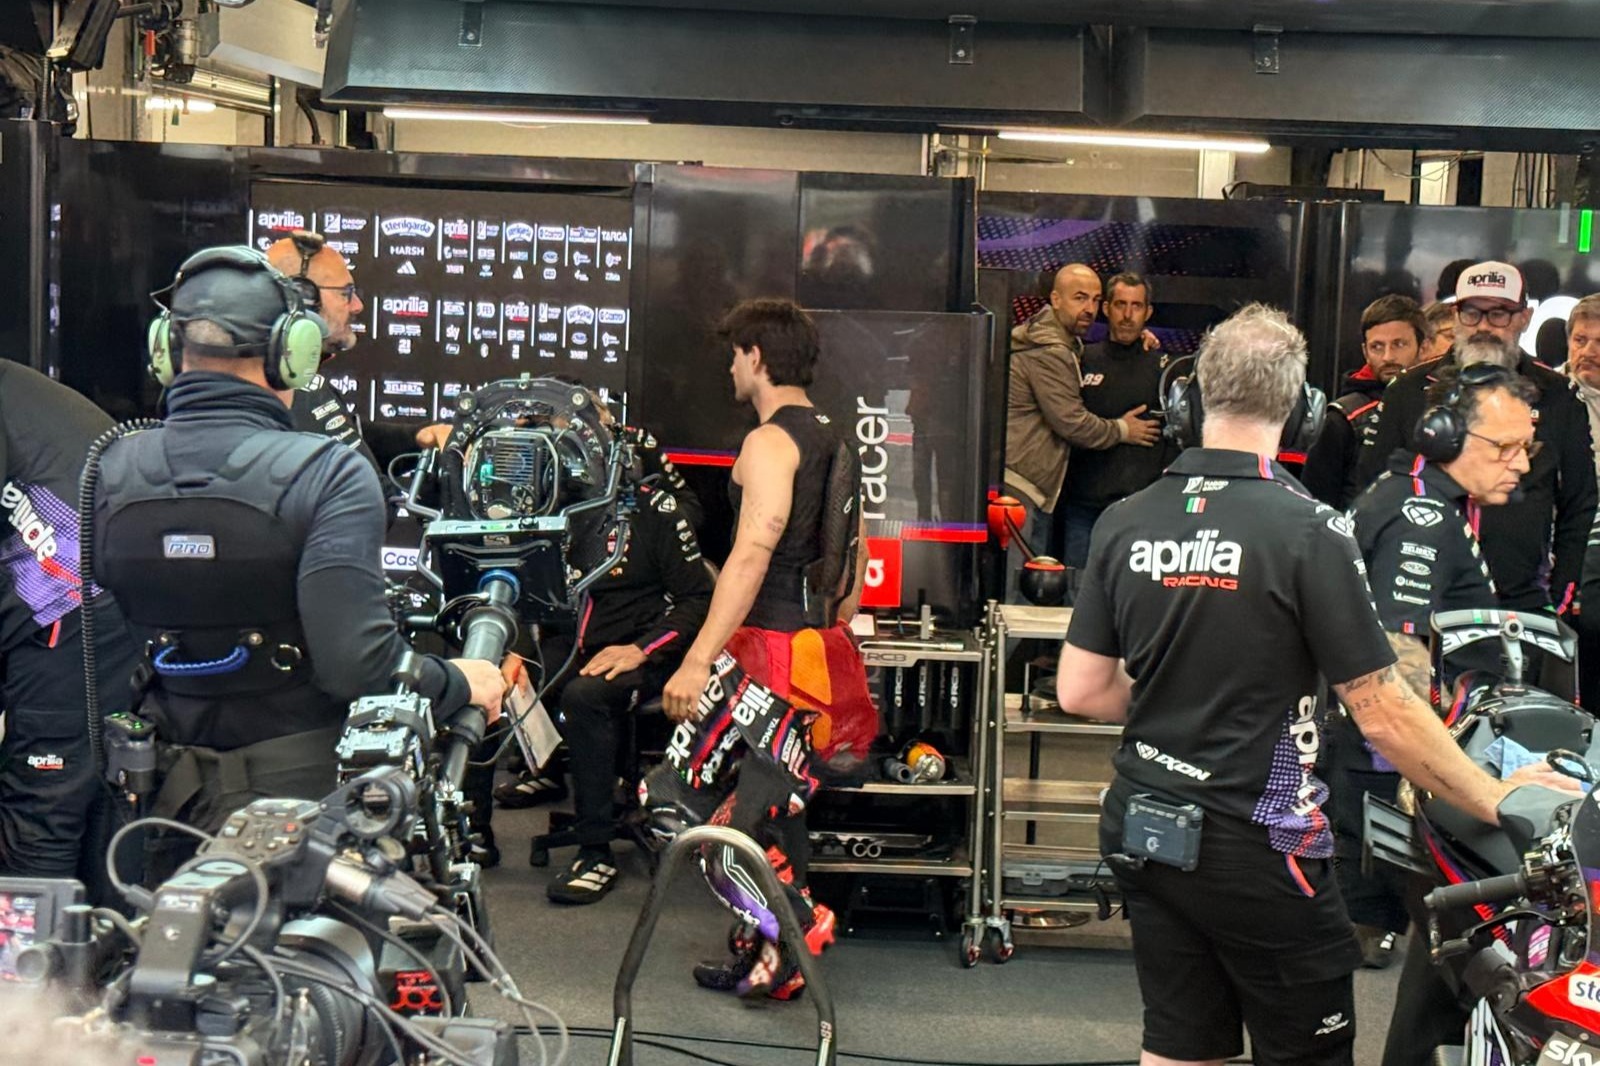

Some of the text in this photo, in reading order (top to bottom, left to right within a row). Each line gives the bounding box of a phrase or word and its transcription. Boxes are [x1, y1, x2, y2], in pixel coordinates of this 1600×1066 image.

[258, 211, 304, 229] aprilia
[601, 231, 627, 241] TARGA
[390, 246, 425, 256] MARSH
[1467, 271, 1506, 286] aprilia
[383, 297, 428, 314] aprilia
[446, 325, 460, 340] sky
[1083, 373, 1104, 386] 89
[855, 396, 889, 520] racer
[1, 481, 58, 562] aprilia
[169, 543, 211, 554] PRO
[1129, 529, 1243, 581] aprilia
[383, 551, 418, 567] Cas
[758, 717, 780, 749] TARGA
[1154, 754, 1212, 781] IXON
